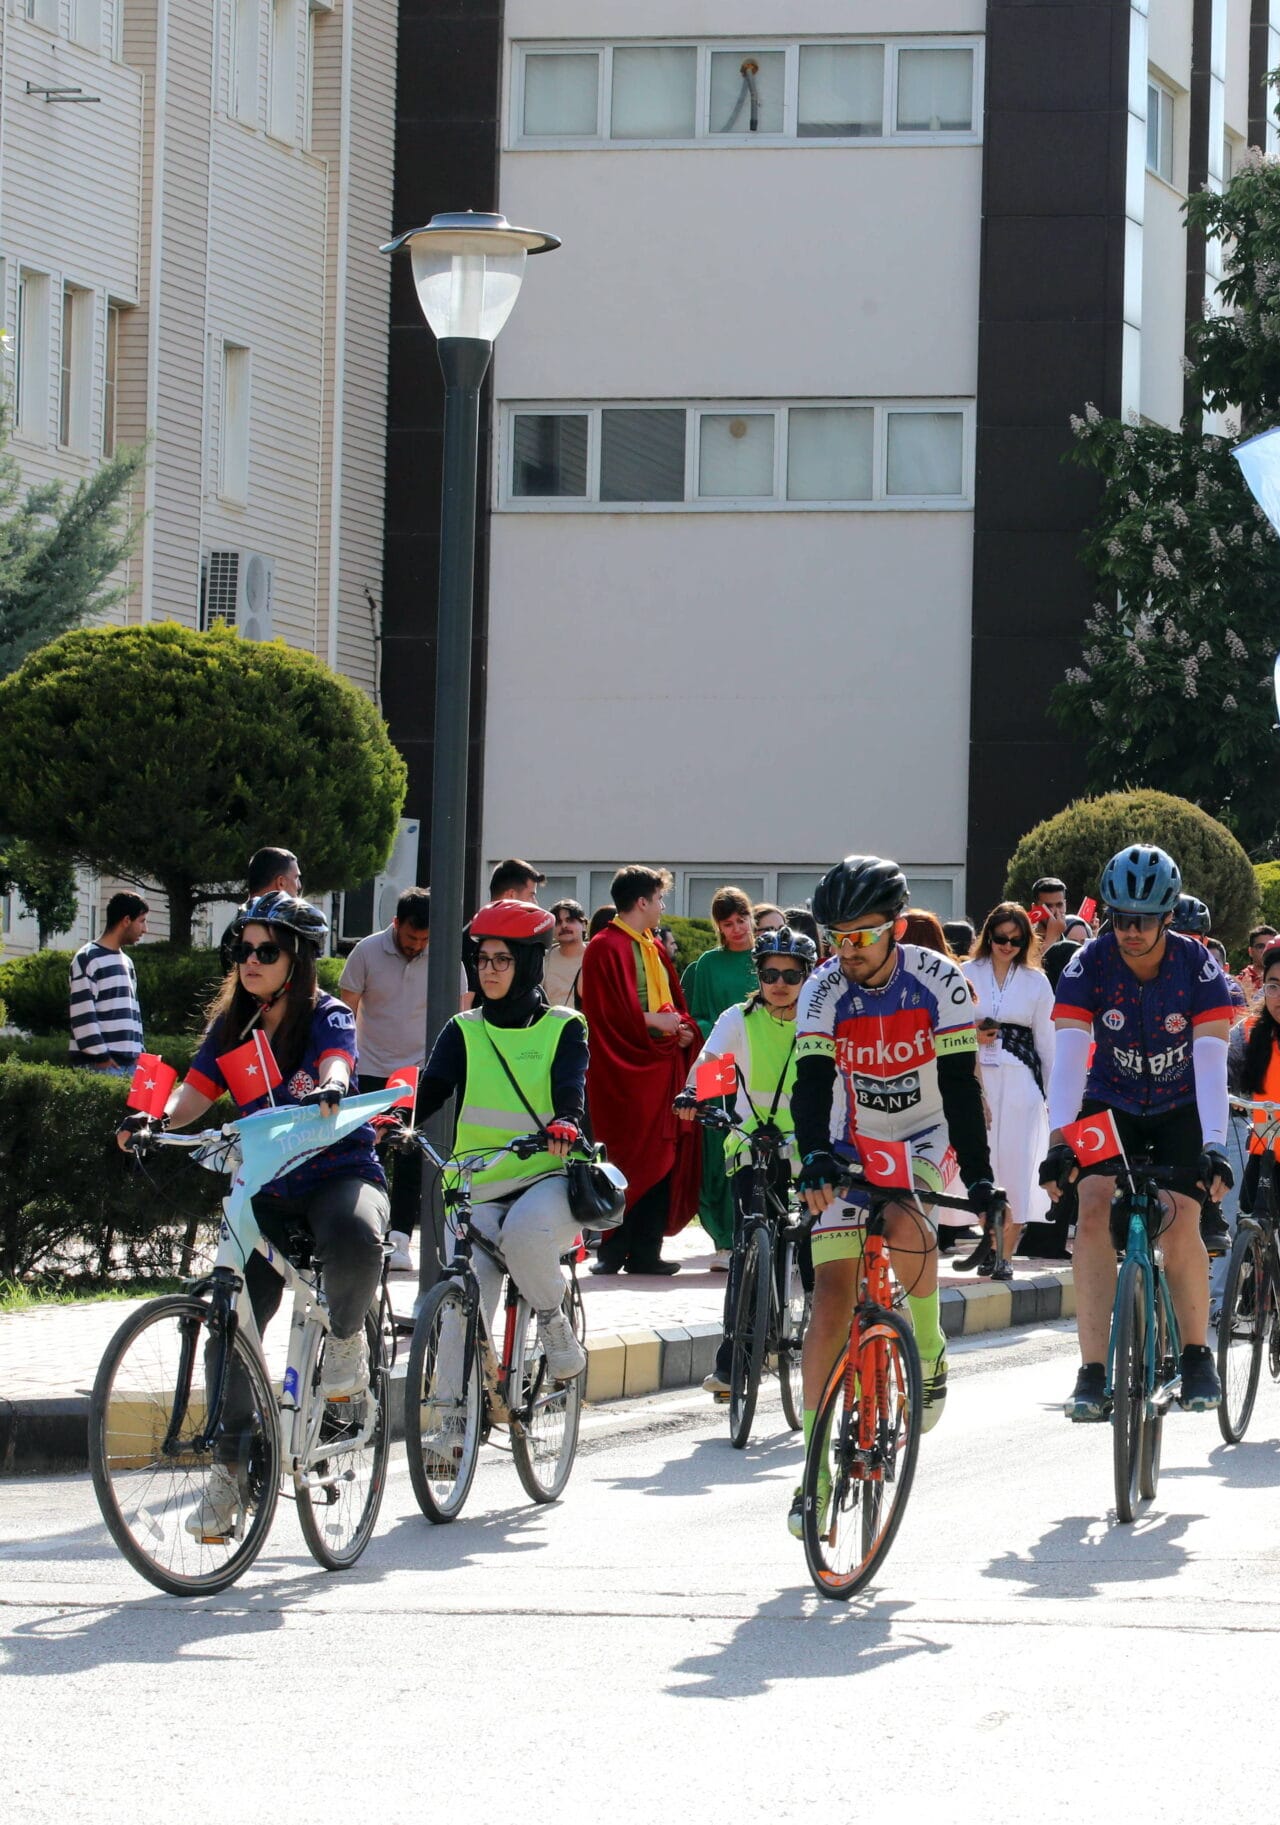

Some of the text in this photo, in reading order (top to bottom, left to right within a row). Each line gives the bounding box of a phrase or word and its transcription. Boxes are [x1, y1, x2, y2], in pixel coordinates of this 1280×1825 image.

[917, 951, 967, 1005] SAXO
[855, 1076, 917, 1093] SAXO
[859, 1090, 920, 1108] BANK
